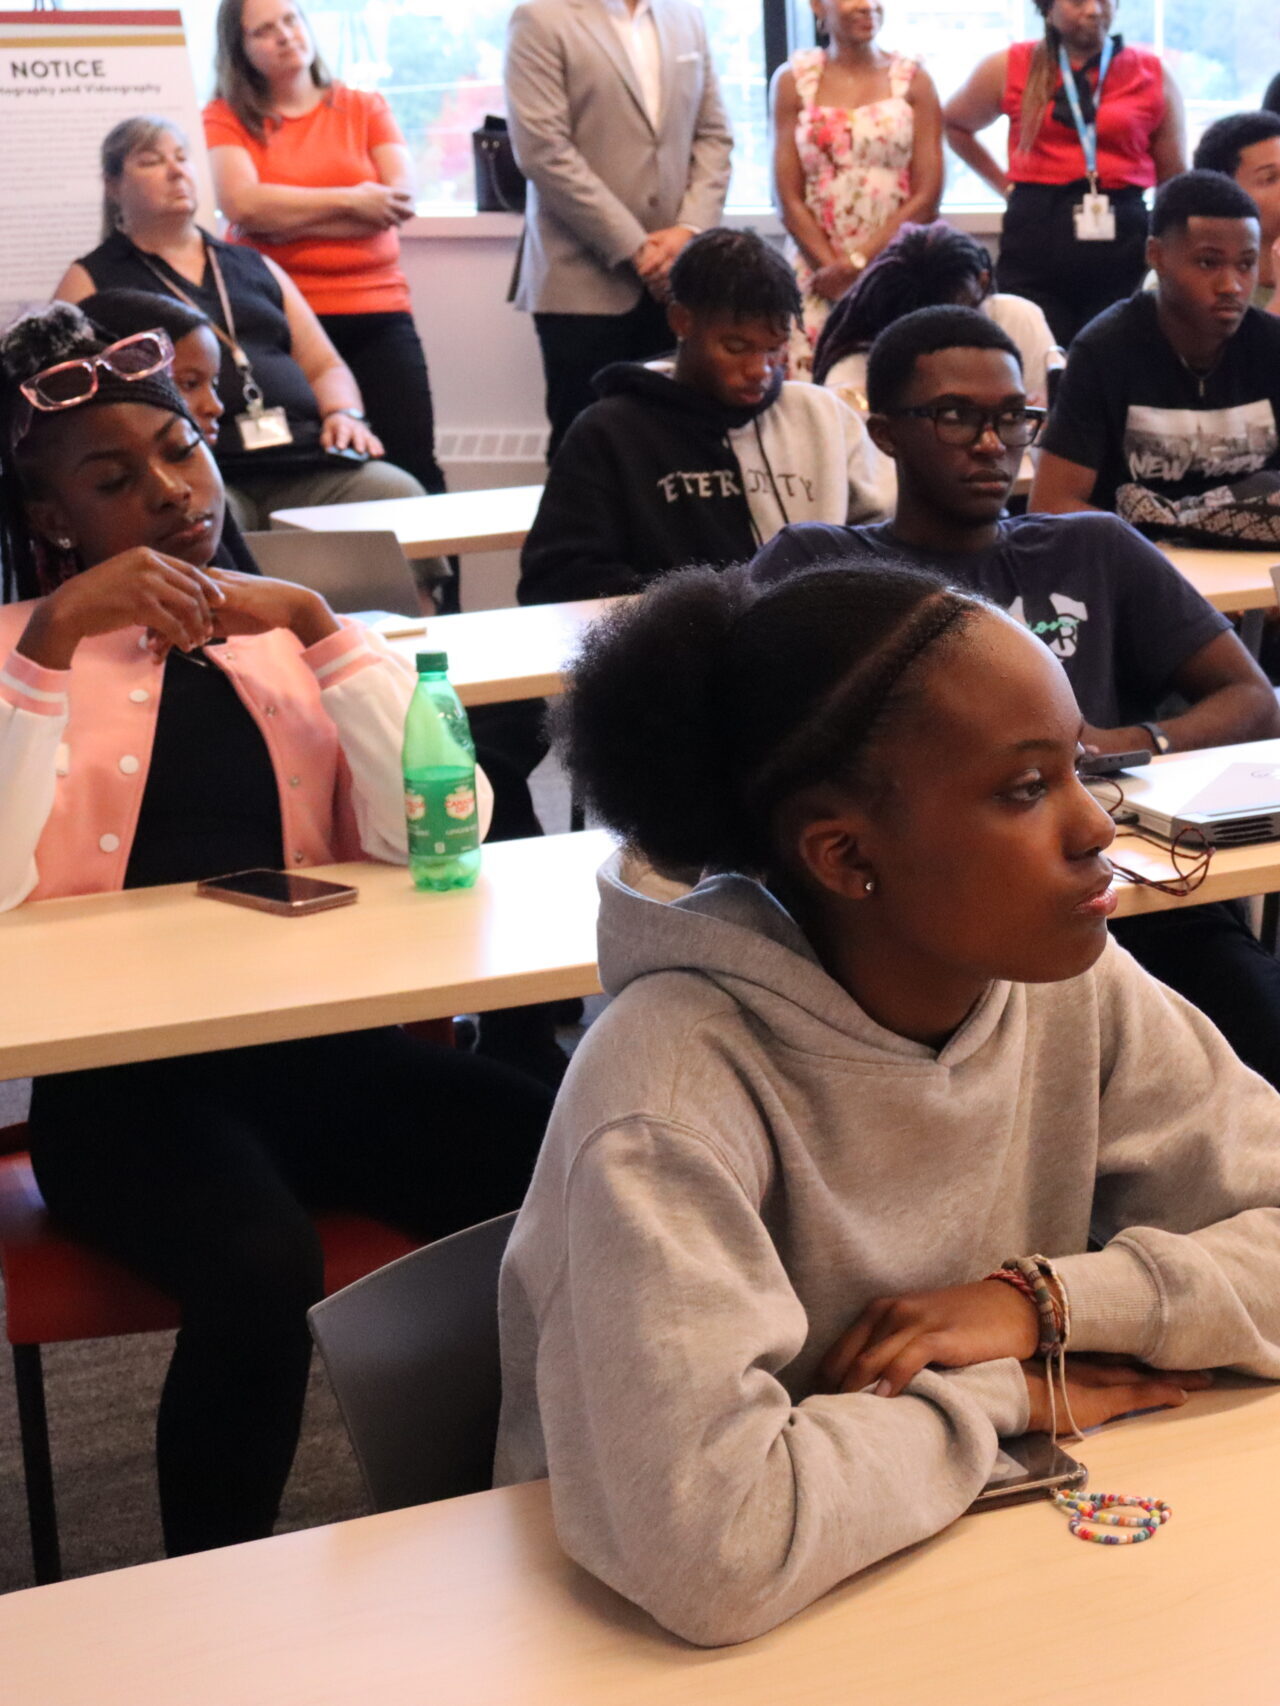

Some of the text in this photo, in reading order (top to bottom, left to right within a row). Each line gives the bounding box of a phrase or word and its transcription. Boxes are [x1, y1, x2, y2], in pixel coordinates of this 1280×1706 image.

[11, 60, 106, 79] NOTICE
[1129, 452, 1192, 481] NEW
[656, 469, 815, 503] ETERNTY
